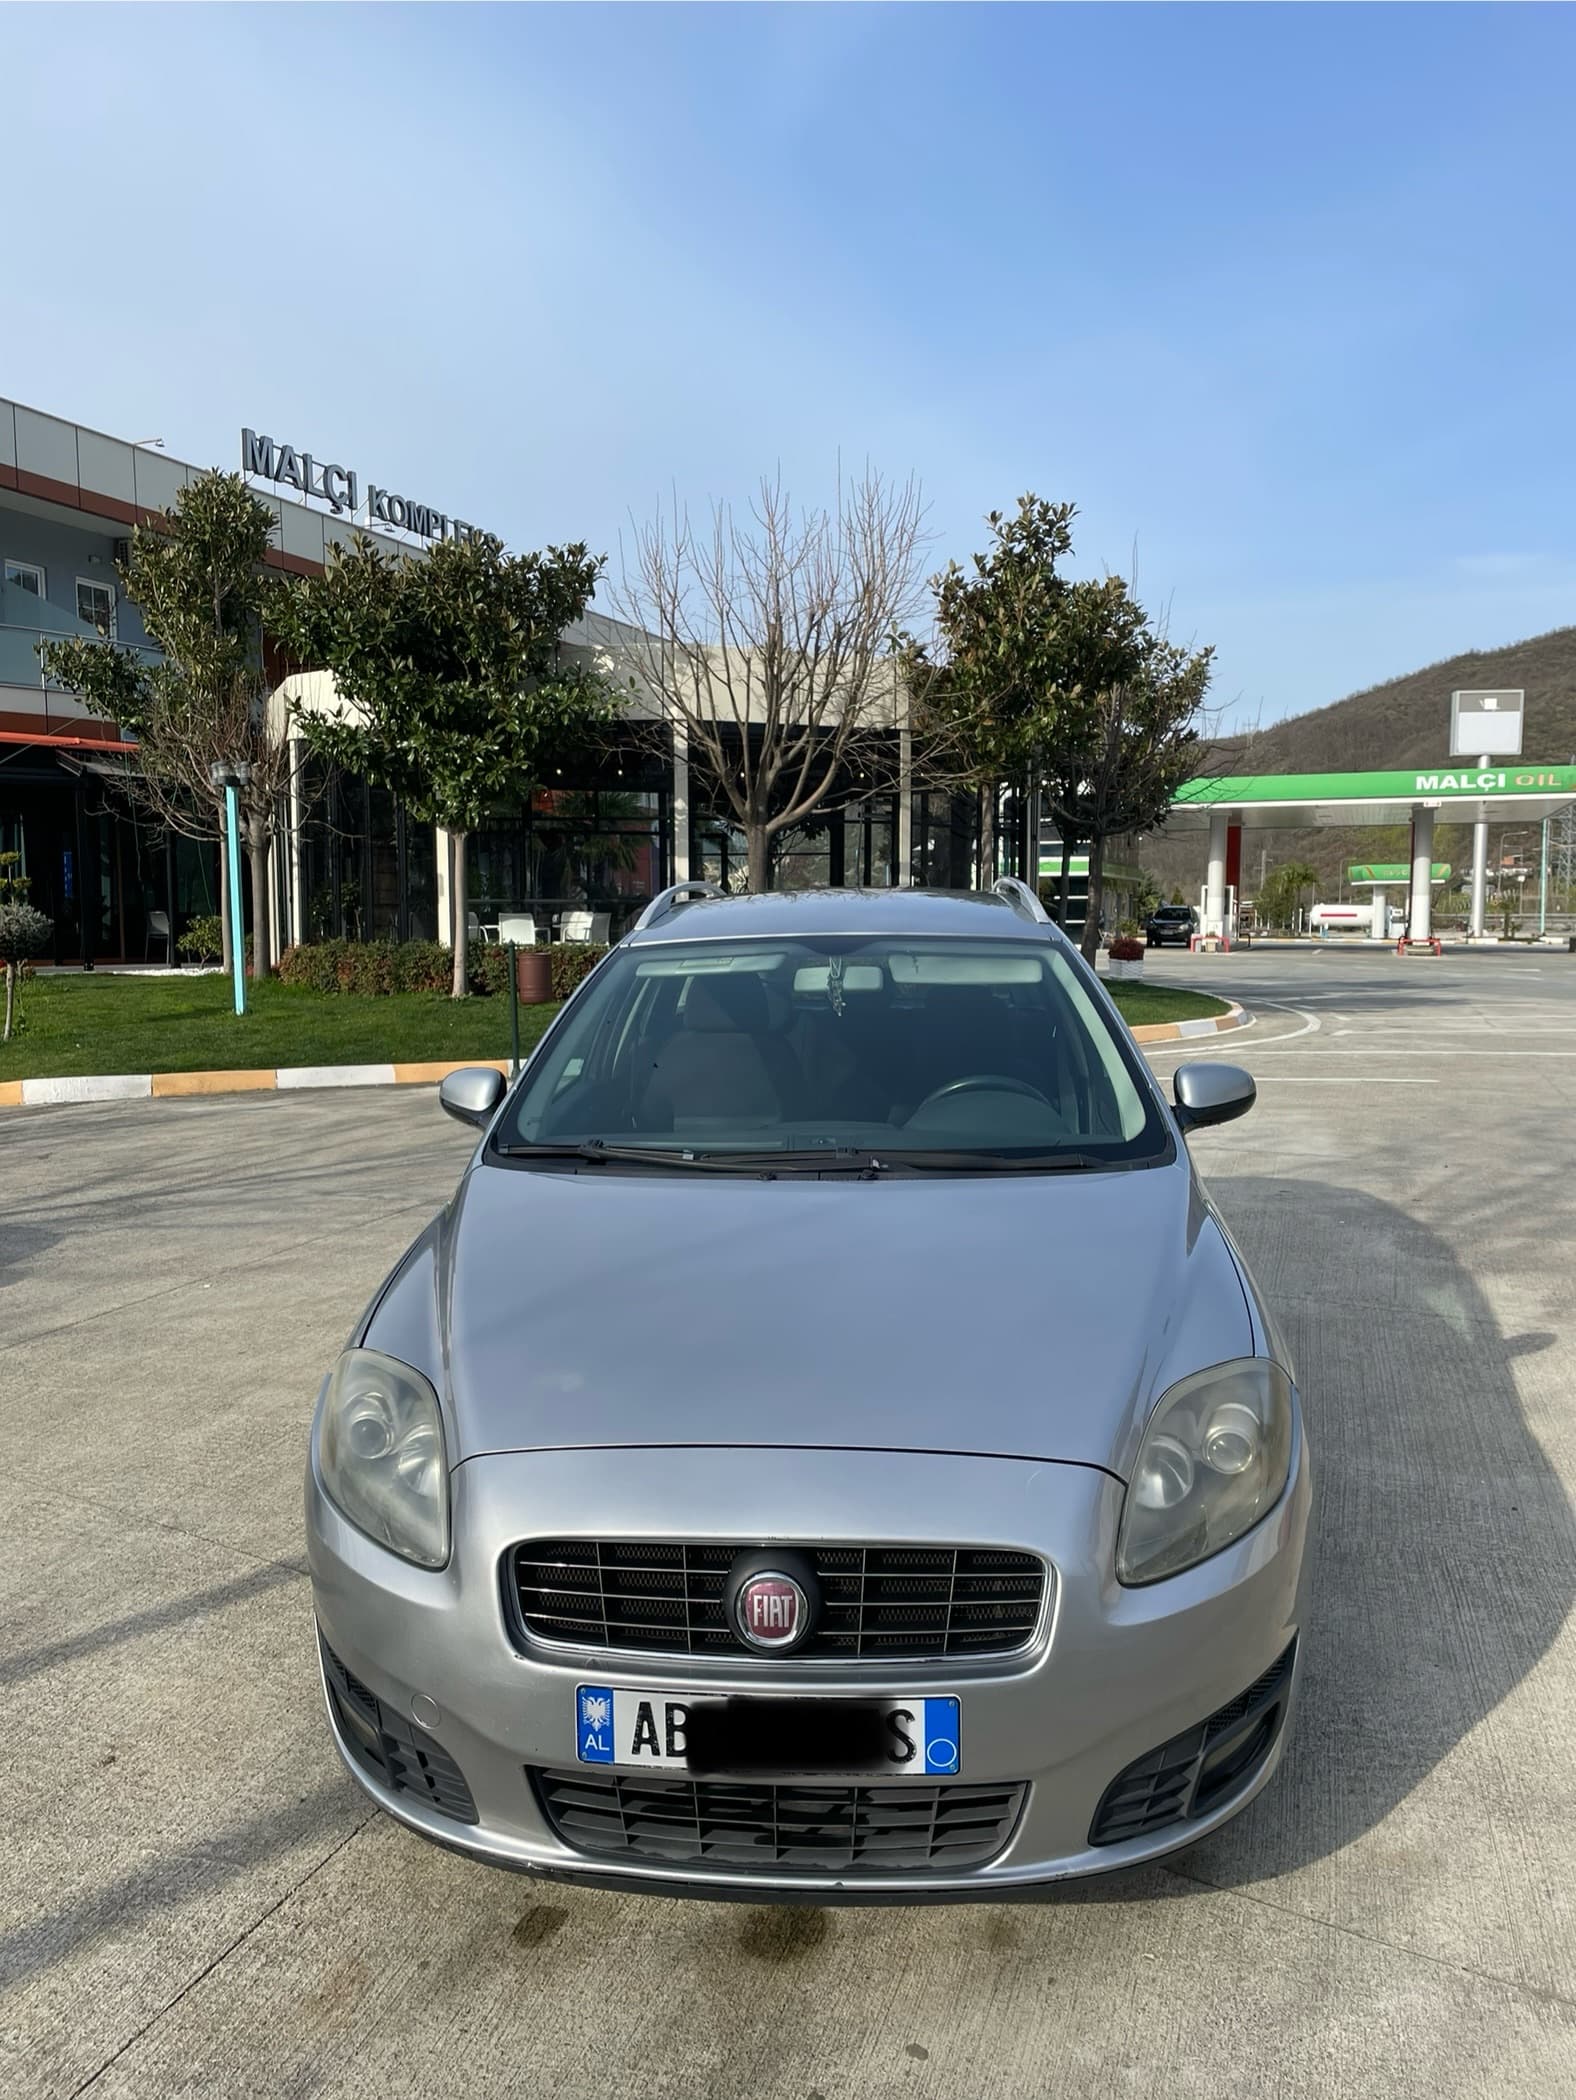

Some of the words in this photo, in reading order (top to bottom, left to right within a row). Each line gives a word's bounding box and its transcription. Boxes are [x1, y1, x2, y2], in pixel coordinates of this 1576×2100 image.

[241, 428, 357, 514] MALÇI
[1416, 773, 1506, 792] MALÇI
[1515, 773, 1562, 786] OIL
[753, 1595, 793, 1628] FIAT
[585, 1734, 610, 1751] AL
[631, 1701, 689, 1757] AB
